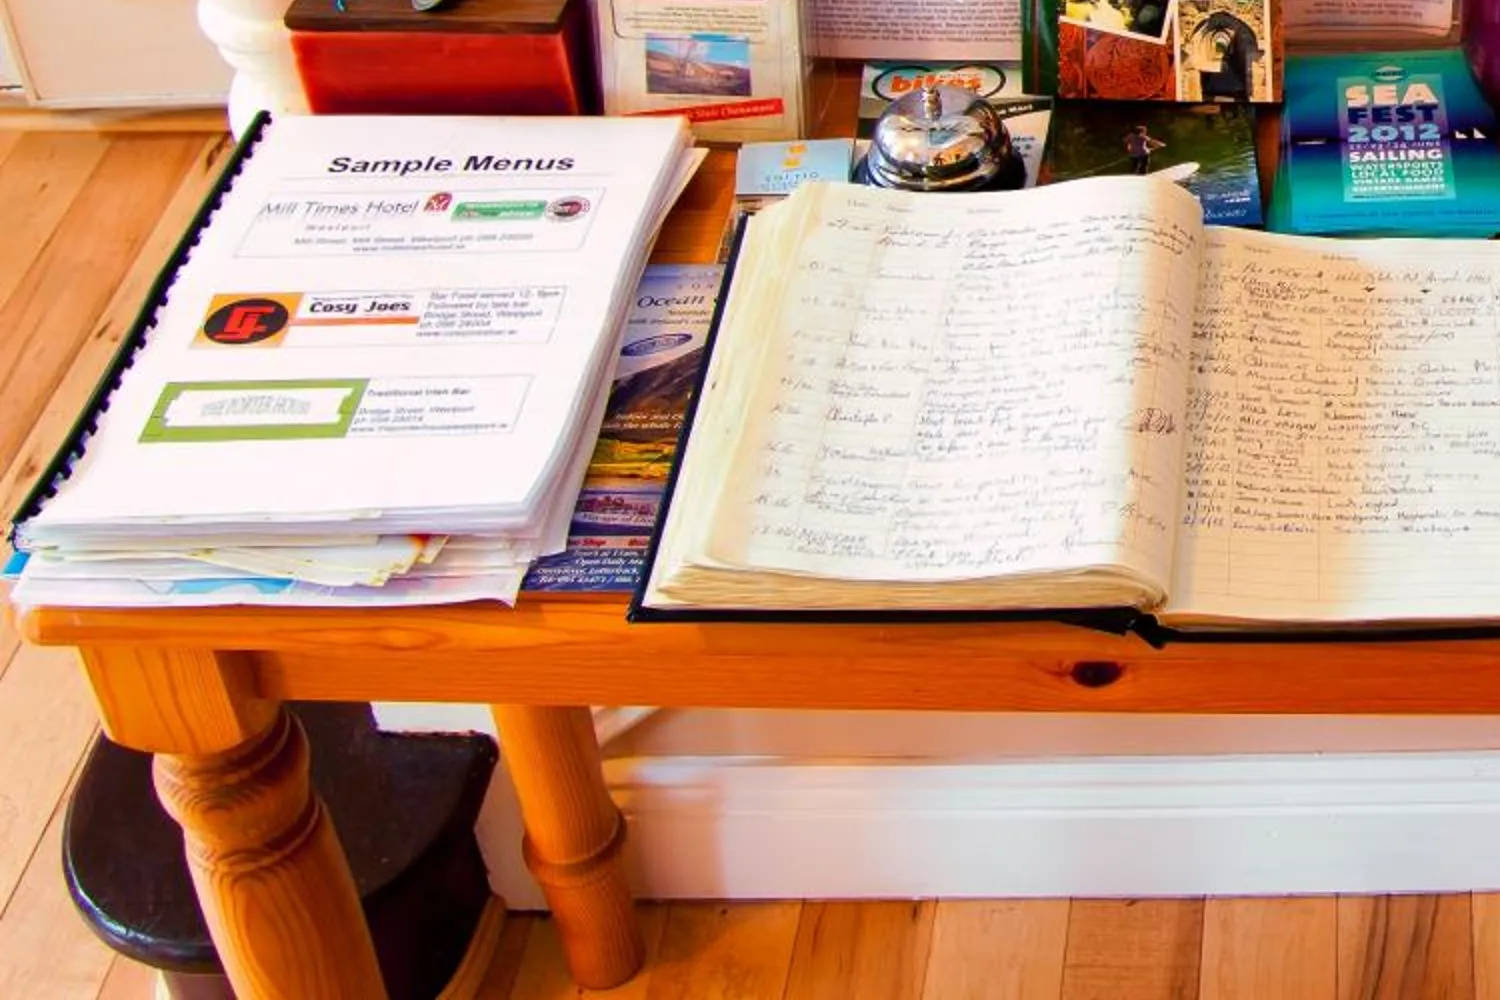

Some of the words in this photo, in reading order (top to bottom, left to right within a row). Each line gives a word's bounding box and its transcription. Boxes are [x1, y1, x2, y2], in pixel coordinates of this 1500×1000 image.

[1345, 83, 1439, 108] SEA
[1348, 104, 1438, 124] FEST
[1348, 123, 1440, 143] 2012
[1349, 148, 1443, 162] SAILING
[327, 155, 453, 176] Sample
[462, 154, 575, 172] Menus
[1351, 170, 1399, 178] LOCAL
[1402, 169, 1444, 178] FOOD
[258, 201, 298, 215] Mill
[304, 200, 359, 216] Times
[365, 200, 420, 214] Hotel
[451, 292, 477, 300] Food
[480, 291, 515, 299] served
[309, 301, 358, 314] Cosy
[364, 301, 410, 313] Joes
